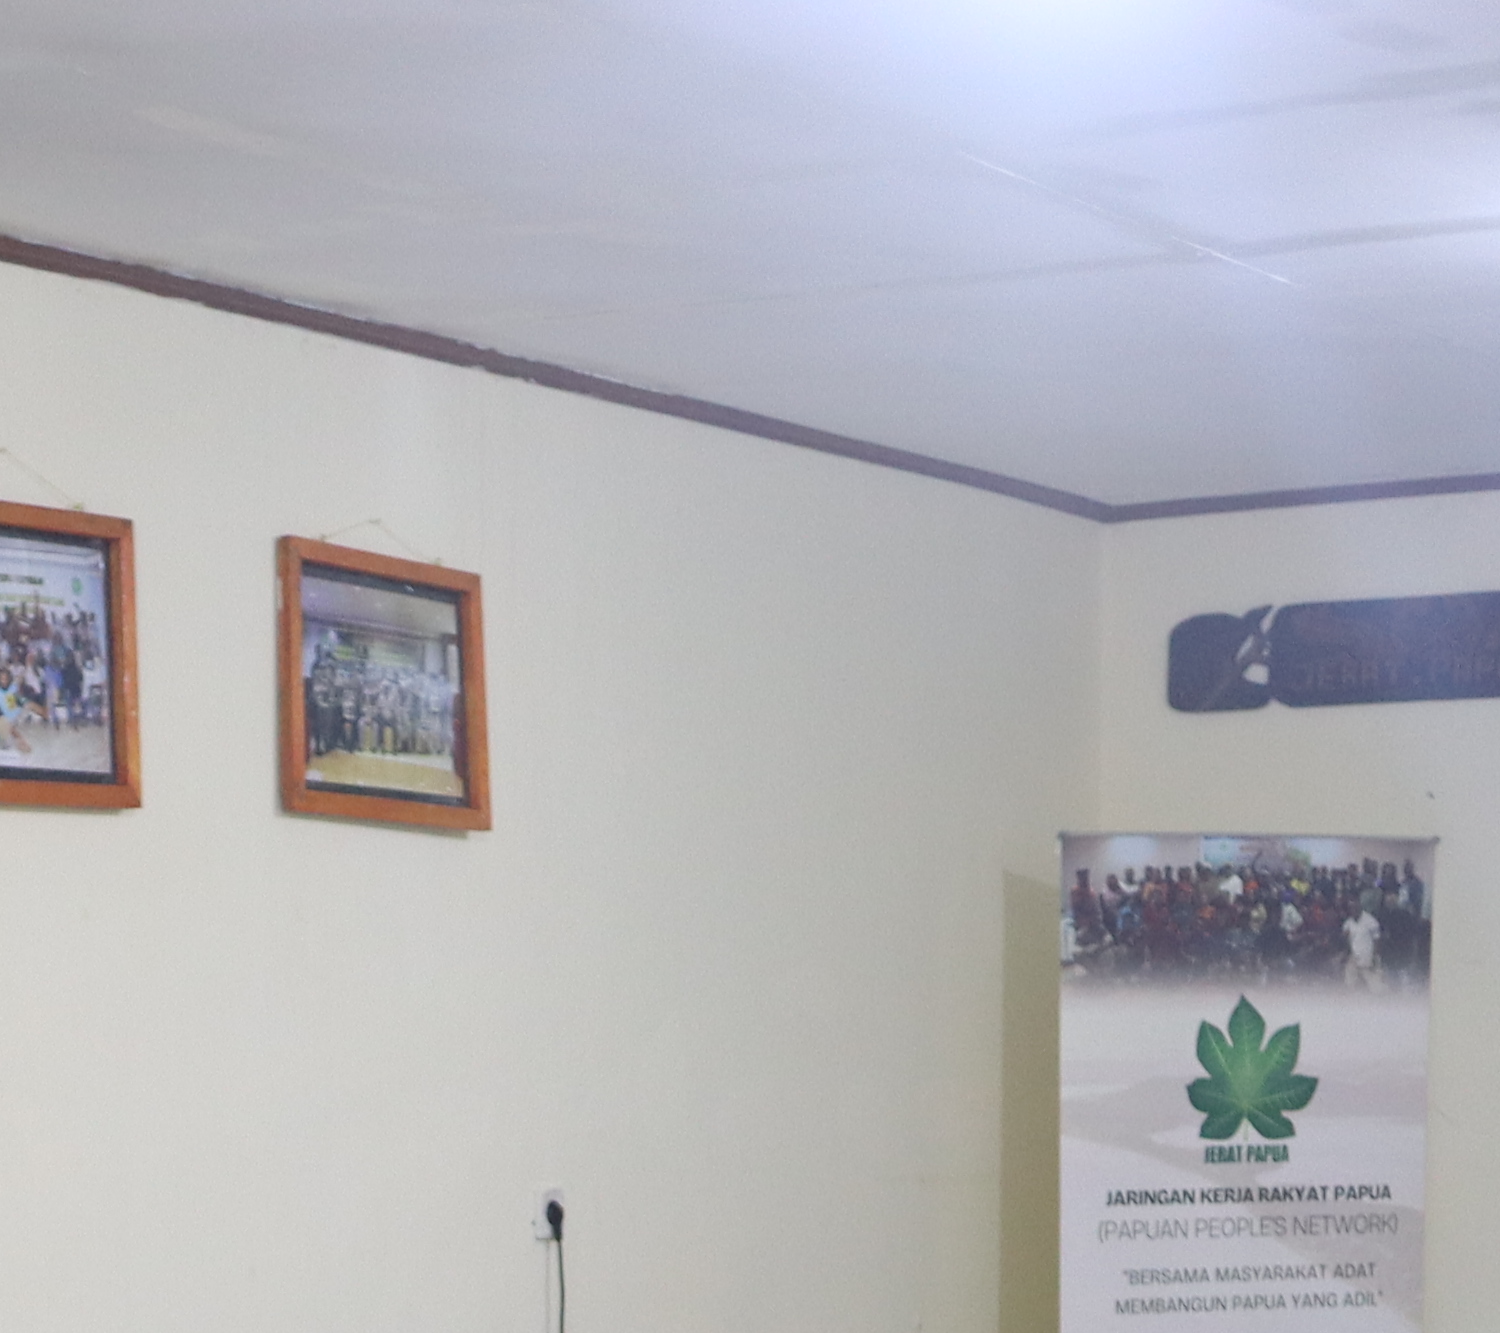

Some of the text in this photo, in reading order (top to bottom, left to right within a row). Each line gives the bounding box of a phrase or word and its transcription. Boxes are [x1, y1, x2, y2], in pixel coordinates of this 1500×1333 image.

[1204, 1144, 1289, 1164] JERAT PAPUA
[1106, 1185, 1392, 1206] JARINGAN KERJA RAKYAT PAPUA
[1098, 1212, 1399, 1243] (PAPUAN PEOPLE'S NETWORK)
[1123, 1262, 1377, 1287] "BERSAMA MASYARAKAT ADAT
[1115, 1290, 1384, 1315] MEMBANGUN PAPUA YANG ADIL"
